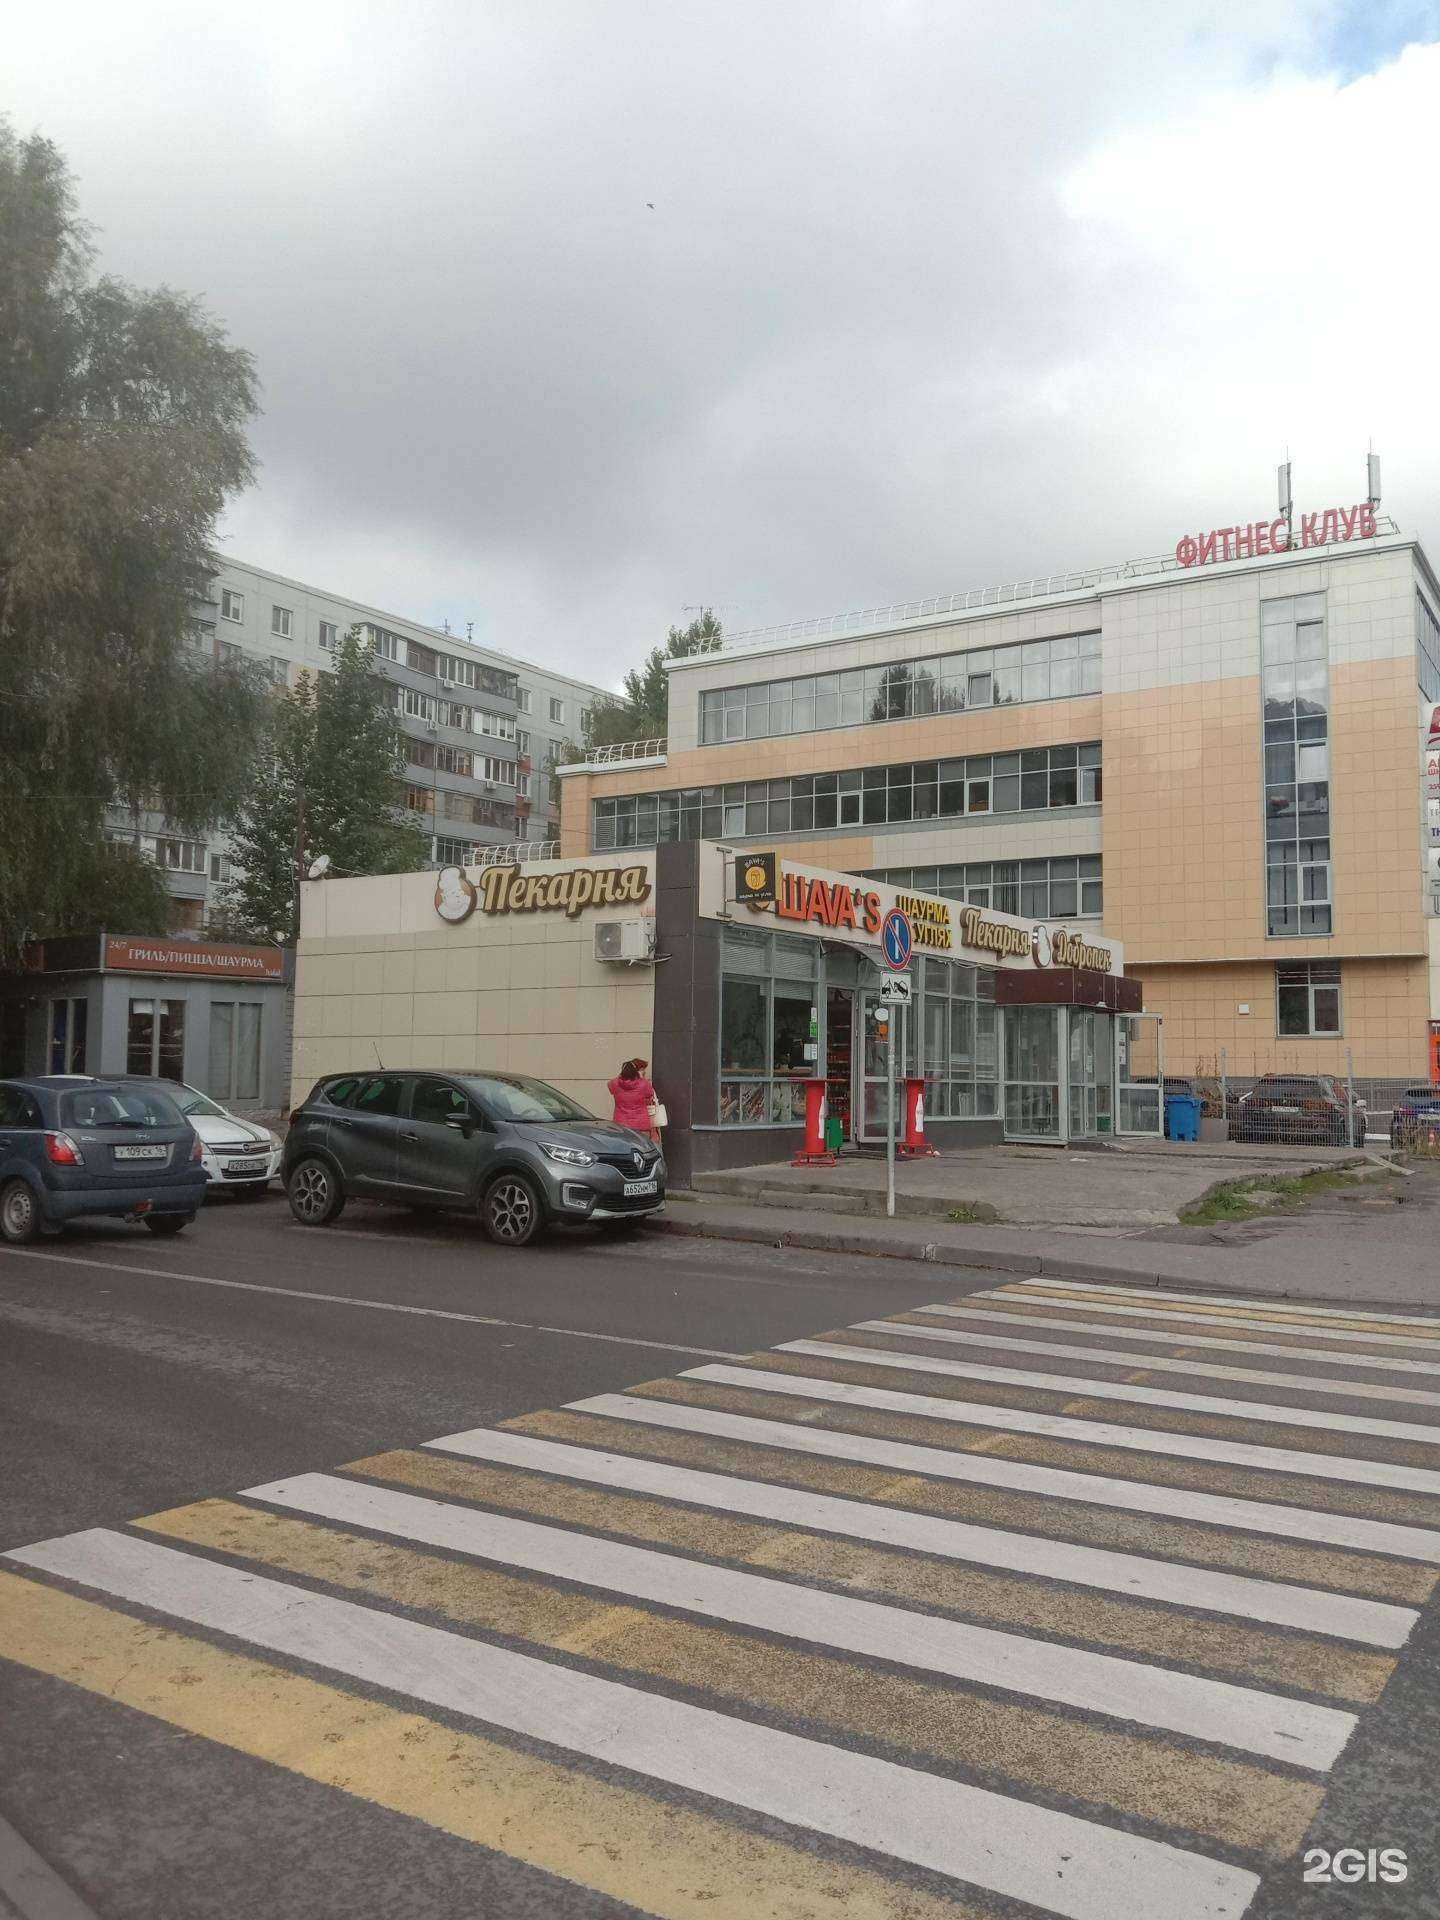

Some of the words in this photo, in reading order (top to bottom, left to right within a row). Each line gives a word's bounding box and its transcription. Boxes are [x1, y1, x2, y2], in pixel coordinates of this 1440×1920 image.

[1176, 518, 1288, 568] ФИТНЕС
[1301, 502, 1378, 549] КЛУБ
[480, 863, 652, 917] Пекарня
[896, 894, 950, 924] ШАУРМА
[960, 907, 1031, 962] Пекарня
